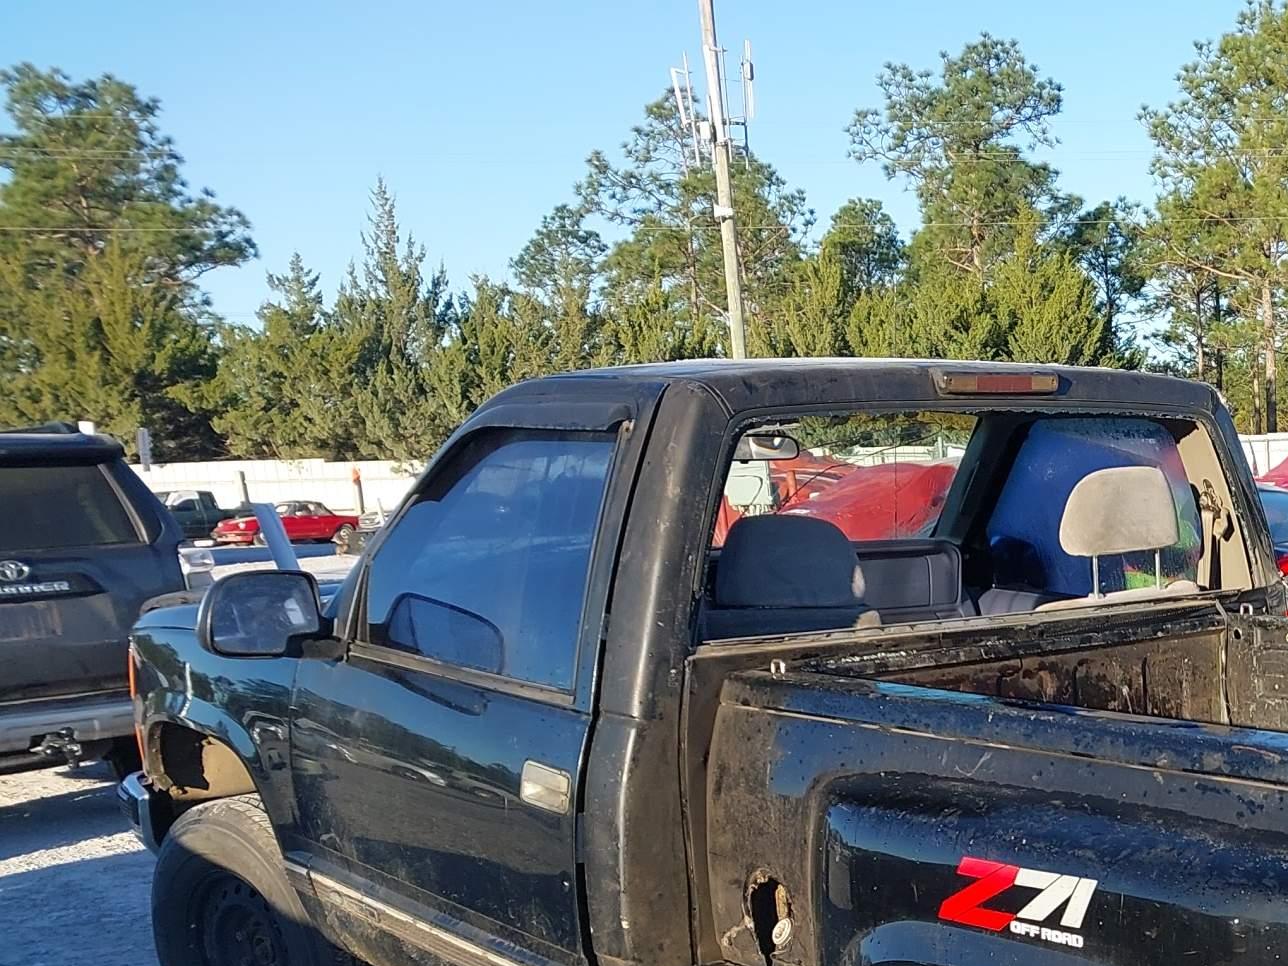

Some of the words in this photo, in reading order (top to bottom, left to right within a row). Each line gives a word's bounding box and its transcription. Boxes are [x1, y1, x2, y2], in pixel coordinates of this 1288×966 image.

[939, 856, 1099, 932] Z71
[1010, 920, 1040, 938] OFF
[1040, 926, 1084, 949] ROAD
